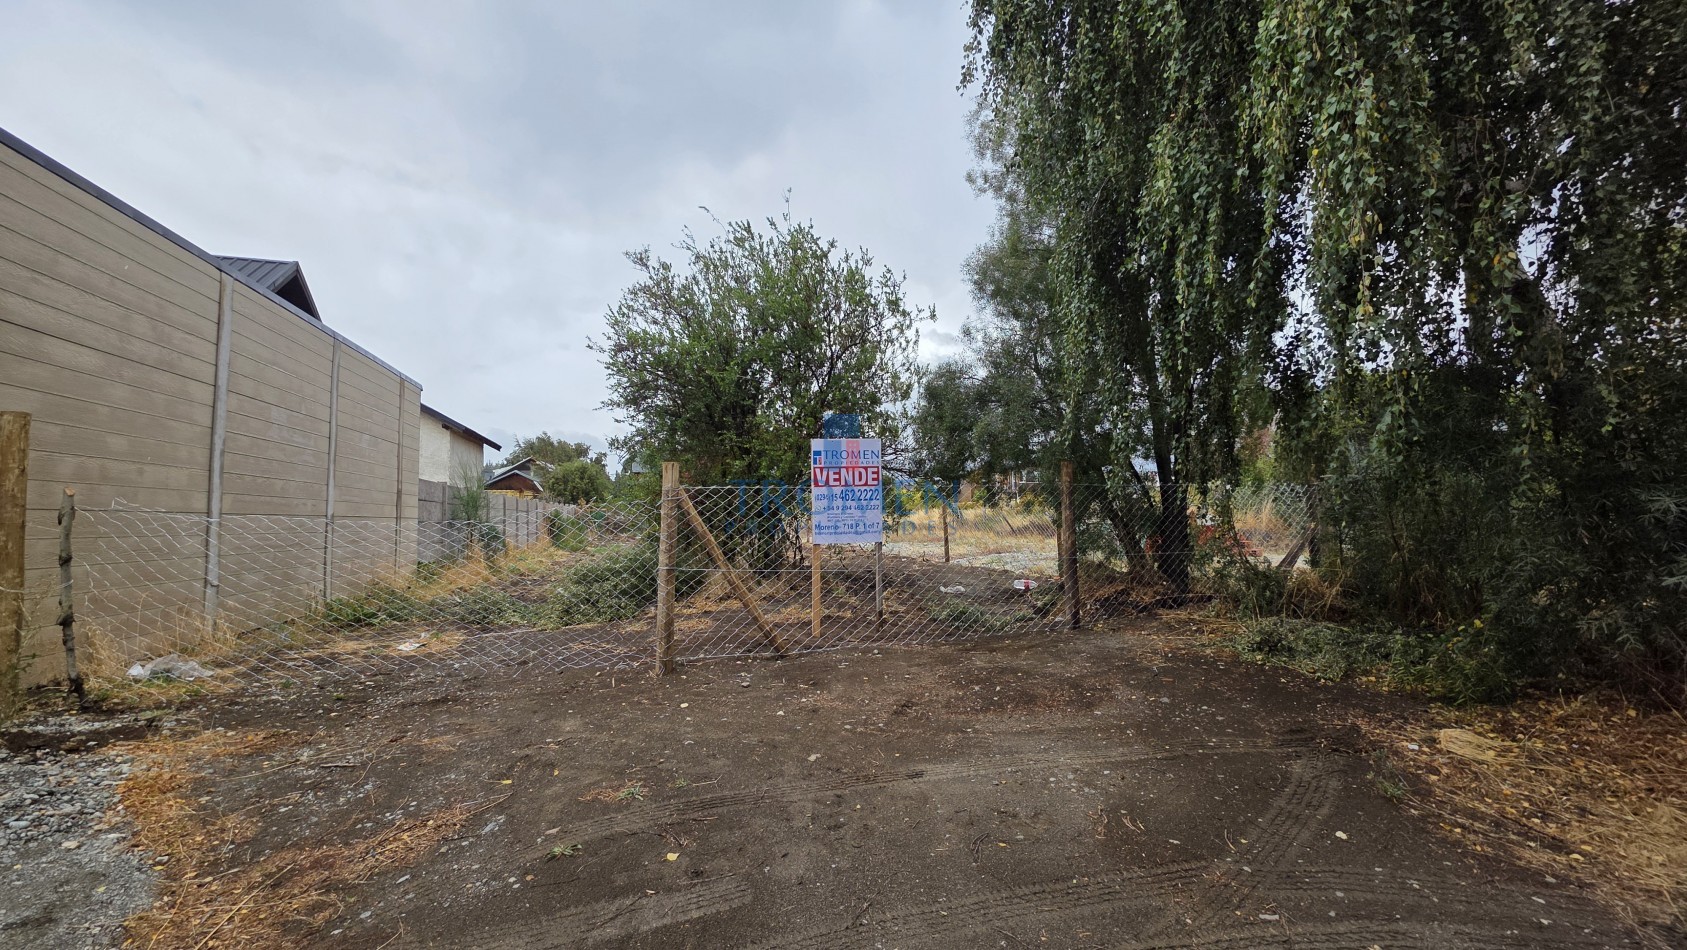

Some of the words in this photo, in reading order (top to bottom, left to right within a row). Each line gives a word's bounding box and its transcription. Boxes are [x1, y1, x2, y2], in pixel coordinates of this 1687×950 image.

[824, 450, 880, 460] TROMEN
[815, 468, 878, 486] VENDE
[838, 489, 856, 502] 462
[857, 489, 880, 501] 2222
